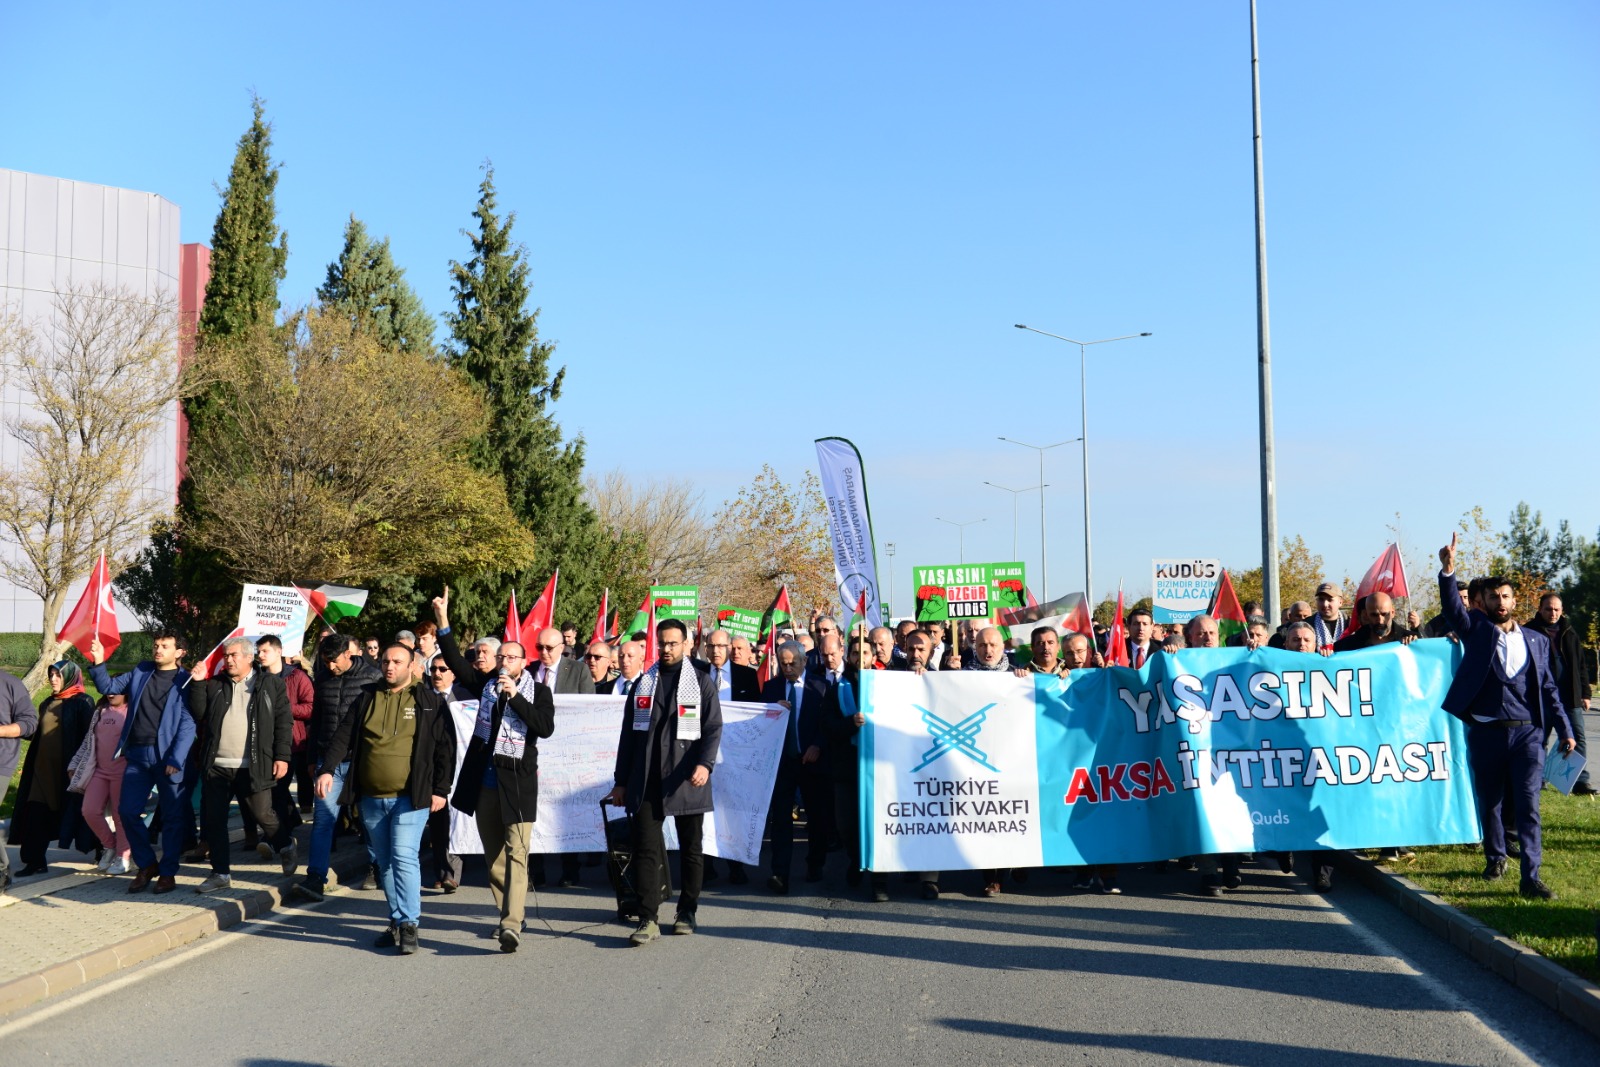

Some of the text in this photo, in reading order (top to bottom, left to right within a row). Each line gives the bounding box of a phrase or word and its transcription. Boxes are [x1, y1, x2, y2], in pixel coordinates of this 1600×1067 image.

[918, 567, 986, 587] YAŞASIN!
[1156, 560, 1215, 578] KUDÜS
[948, 586, 986, 601] ÖZGÜR
[949, 603, 986, 616] KUDÜS
[1119, 668, 1375, 733] YAŞASIN!
[1064, 739, 1450, 805] AKSA İNTİFADASI
[913, 777, 999, 797] TÜRKİYE
[887, 798, 1029, 818] GENÇLİK VAKFI
[885, 819, 1027, 836] KAHRAMANMARAŞ
